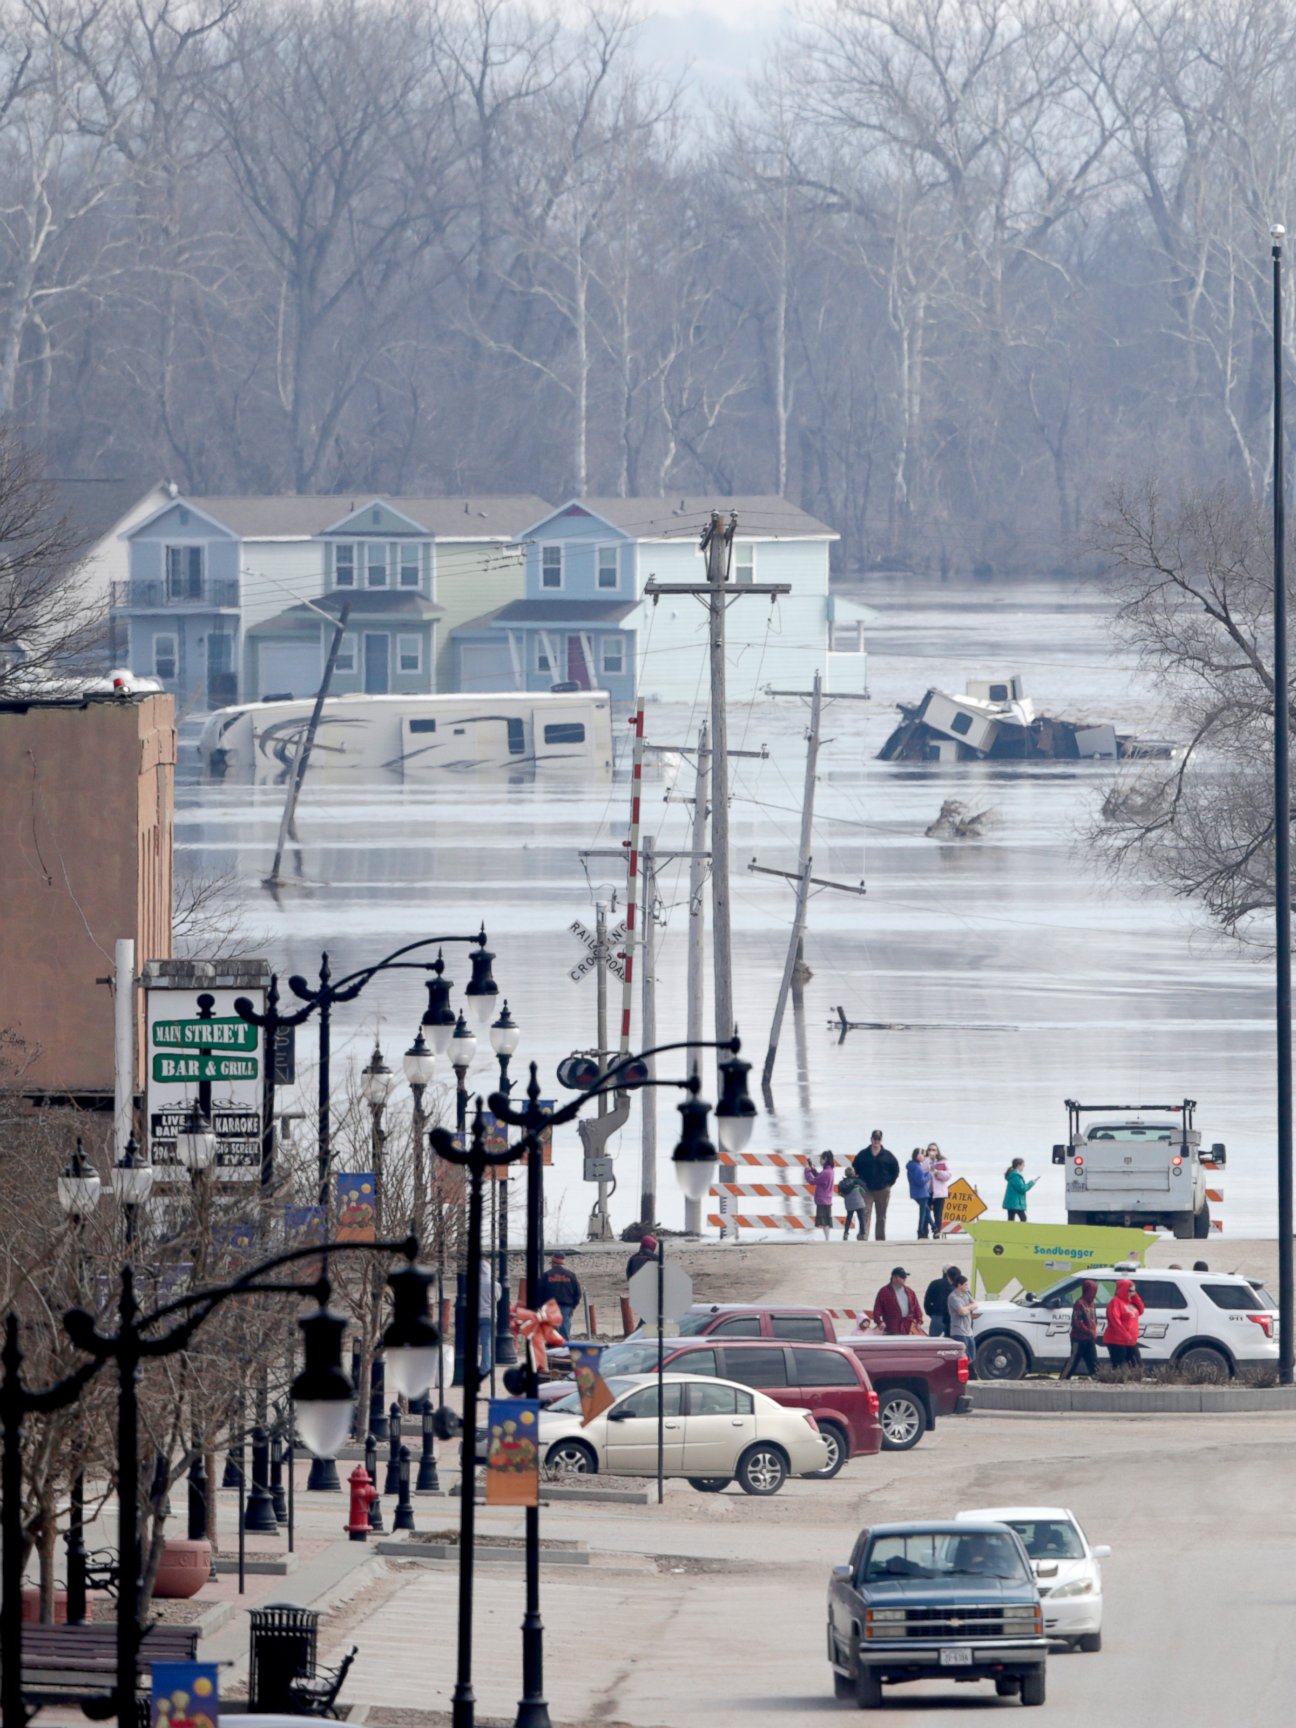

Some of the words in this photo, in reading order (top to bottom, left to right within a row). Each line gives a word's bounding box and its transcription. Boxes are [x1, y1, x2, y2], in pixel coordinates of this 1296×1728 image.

[156, 1025, 181, 1042] MAIN
[184, 1023, 248, 1044] STREET
[161, 1060, 199, 1076] BAR
[205, 1061, 216, 1076] &
[220, 1061, 254, 1075] GRILL
[162, 1115, 186, 1126] LIVE
[215, 1117, 258, 1133] KARAOKE
[946, 1202, 968, 1212] OVER
[944, 1212, 967, 1222] ROAD
[1033, 1245, 1094, 1258] Sandbagger
